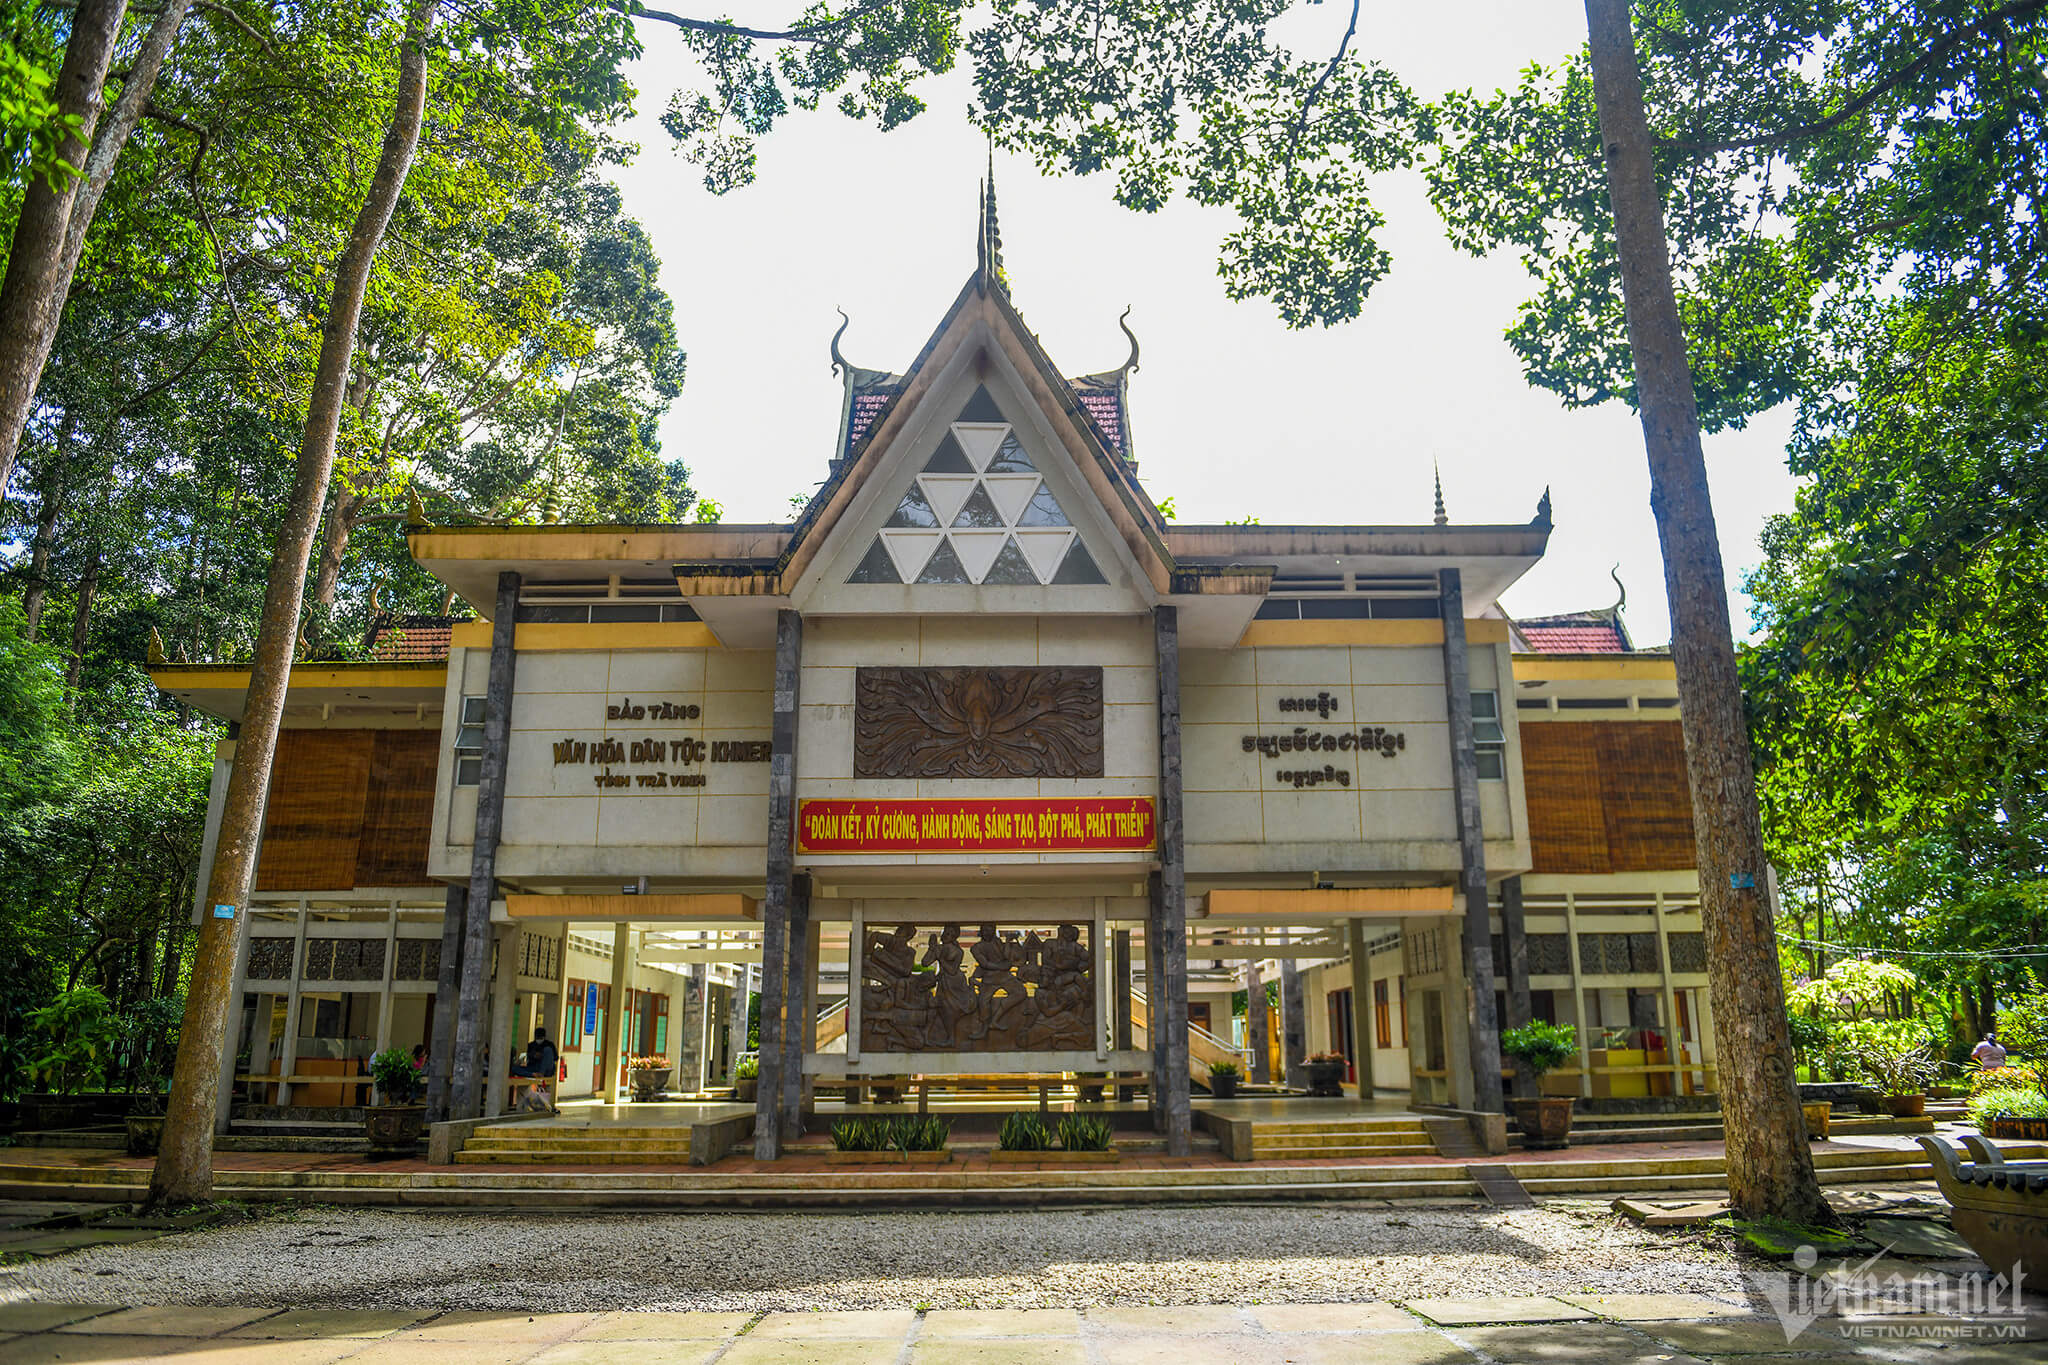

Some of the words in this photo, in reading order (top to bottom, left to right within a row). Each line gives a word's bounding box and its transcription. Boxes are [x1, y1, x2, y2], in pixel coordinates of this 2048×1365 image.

[607, 698, 646, 720] BẢO
[648, 702, 700, 720] TÀNG
[553, 738, 587, 767] VĂN
[589, 737, 626, 764] HÓA
[630, 738, 666, 764] DÂN
[670, 737, 706, 766] TỘC
[711, 740, 772, 762] KHMER
[594, 766, 631, 787] TỈNH
[636, 771, 667, 788] TRÀ
[670, 774, 706, 788] VINH
[841, 803, 864, 846] KẾT,
[866, 804, 880, 840] KỶ
[882, 809, 920, 845] CƯƠNG,
[922, 807, 950, 839] HÀNH
[952, 808, 983, 847] ĐỘNG,
[985, 806, 1012, 839] SÁNG
[1014, 813, 1037, 846] TẠO,
[1039, 807, 1059, 846] ĐỘT
[1061, 805, 1084, 843] PHÁ,
[1086, 805, 1112, 838] PHÁT
